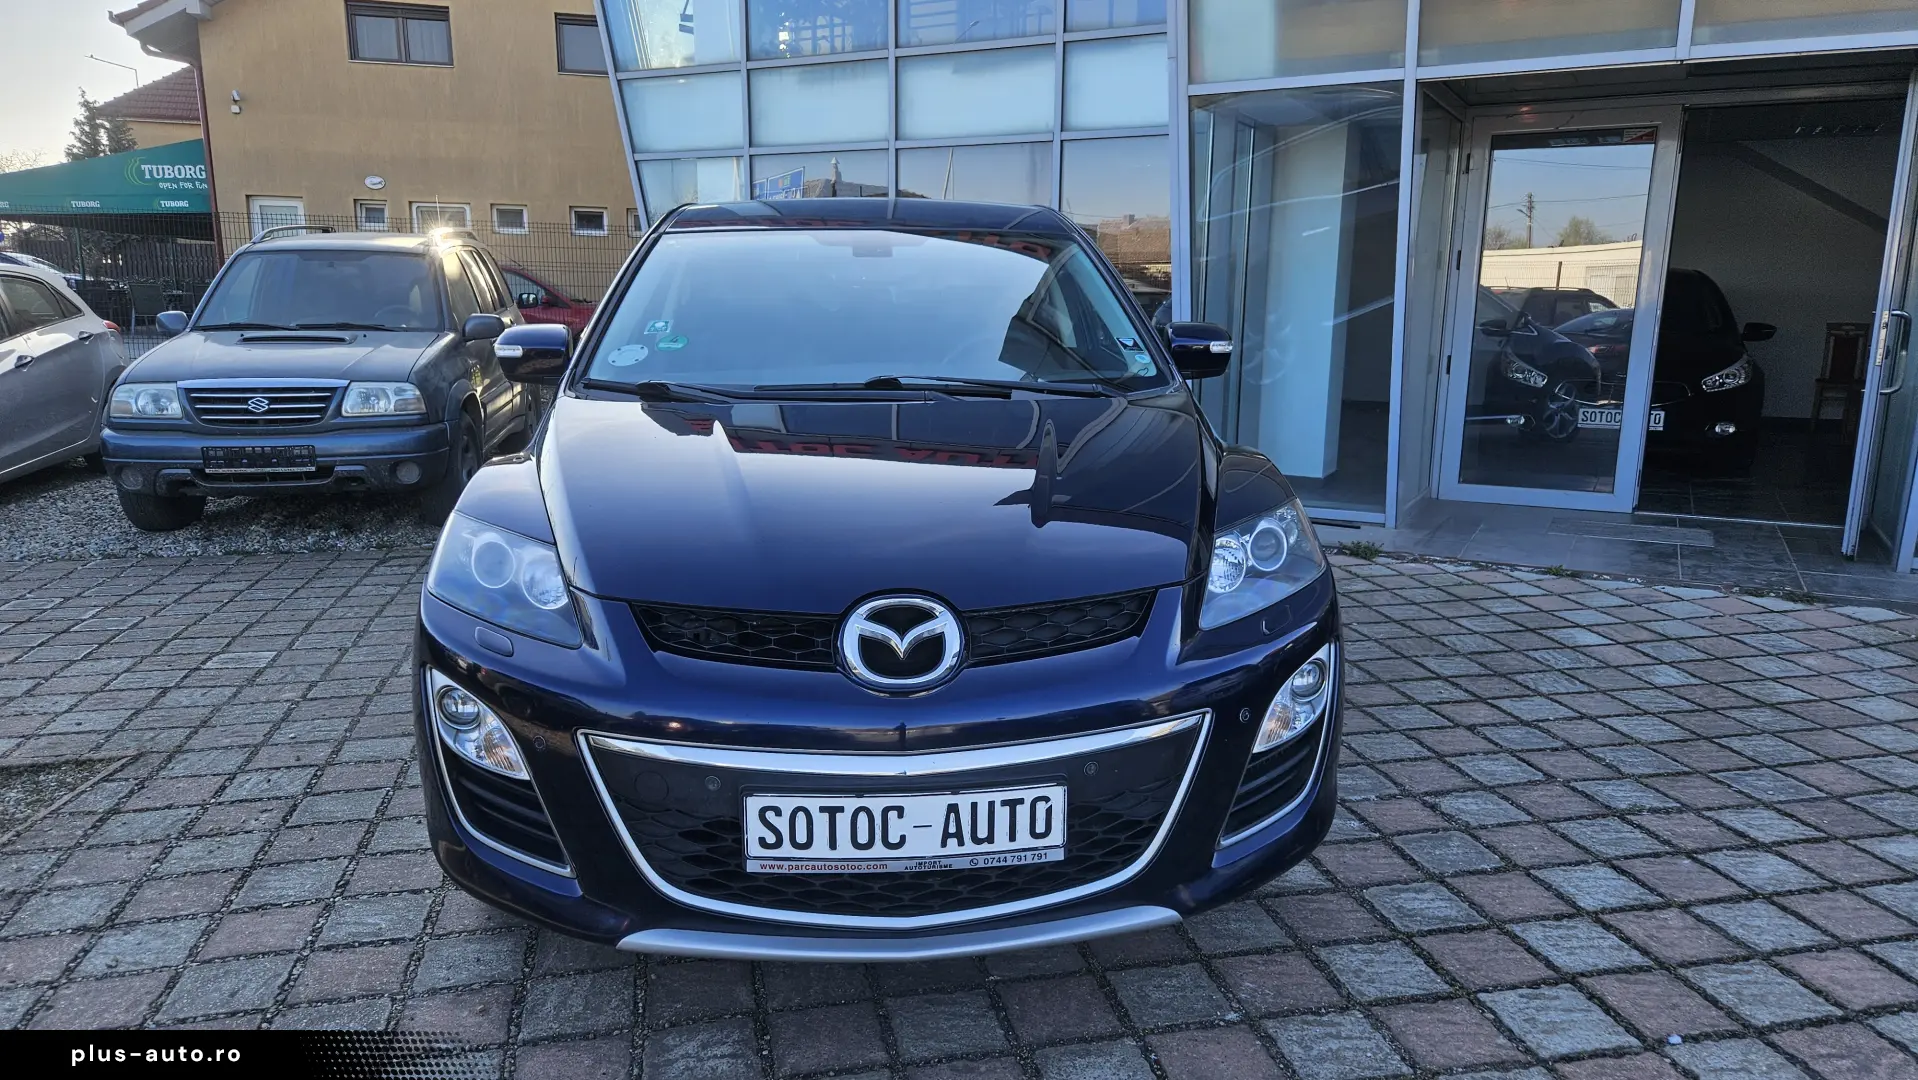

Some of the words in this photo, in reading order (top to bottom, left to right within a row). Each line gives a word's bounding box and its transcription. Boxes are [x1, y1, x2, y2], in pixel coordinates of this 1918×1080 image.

[141, 165, 206, 178] TUBORG
[179, 181, 194, 189] FOR
[160, 200, 189, 208] TUBORG
[983, 856, 1007, 865] 0744
[1010, 854, 1027, 863] 791
[1031, 852, 1048, 860] 791
[760, 862, 888, 872] www.parcautosotoc.com
